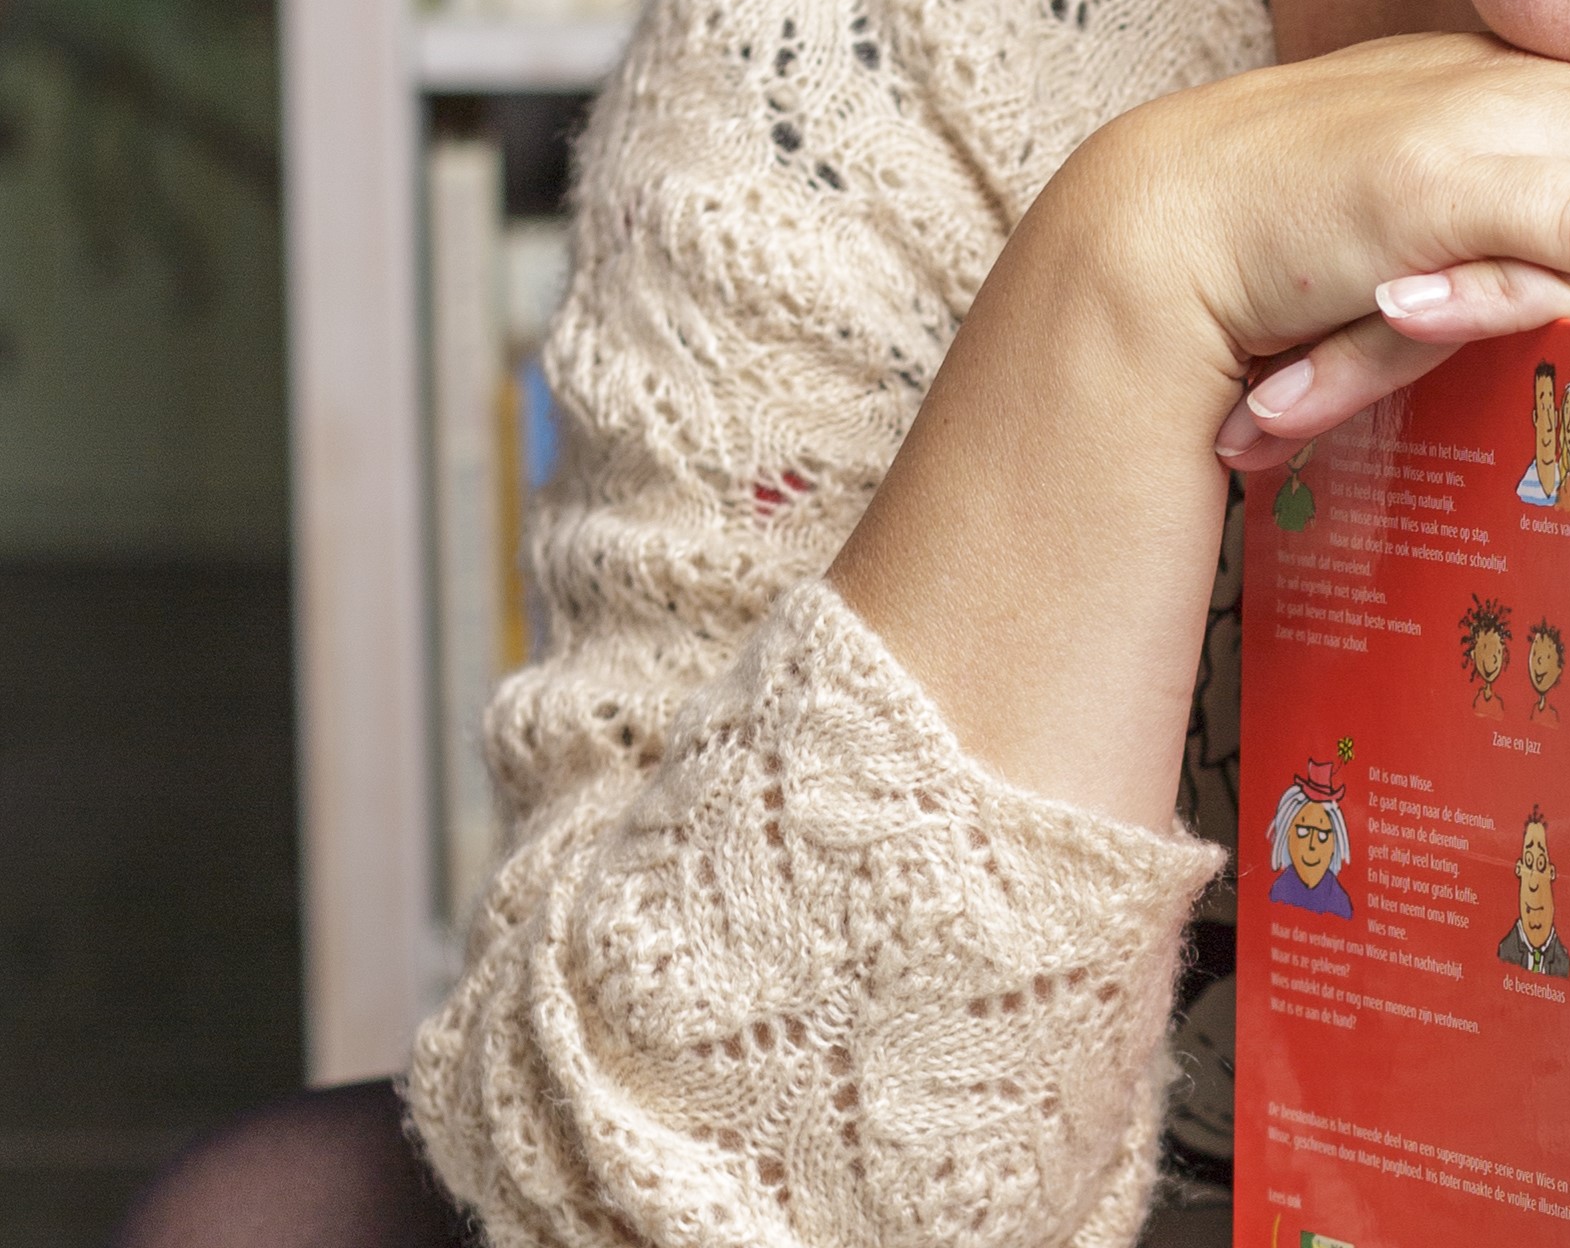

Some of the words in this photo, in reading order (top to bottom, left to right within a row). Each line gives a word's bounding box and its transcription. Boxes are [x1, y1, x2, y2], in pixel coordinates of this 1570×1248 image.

[1438, 442, 1450, 459] het
[1452, 444, 1495, 466] buitenland.
[1426, 470, 1443, 484] voor
[1445, 470, 1466, 487] Wies.
[1418, 494, 1456, 515] natuurlijk.
[1400, 516, 1419, 533] Wies
[1420, 519, 1439, 535] vaak
[1440, 524, 1458, 539] mee
[1459, 528, 1470, 543] op
[1471, 528, 1490, 547] stap.
[1520, 513, 1530, 530] de
[1531, 516, 1558, 535] ouders
[1395, 541, 1409, 556] ook
[1445, 549, 1468, 565] onder
[1469, 552, 1509, 574] schooltijd.
[1364, 611, 1386, 630] beste
[1387, 617, 1422, 636] vrienden
[1492, 731, 1512, 749] Zane
[1513, 738, 1524, 751] en
[1525, 737, 1541, 756] Jazz
[1369, 765, 1380, 782] Dit
[1382, 767, 1389, 784] is
[1390, 772, 1408, 788] oma
[1409, 774, 1435, 792] Wisse.
[1369, 791, 1379, 808] Ze
[1379, 797, 1398, 813] gaat
[1398, 800, 1421, 820] graag
[1422, 805, 1440, 819] naar
[1442, 805, 1452, 822] de
[1454, 807, 1497, 831] dierentuin.
[1368, 817, 1380, 834] De
[1380, 818, 1399, 837] baas
[1401, 826, 1416, 840] van
[1417, 825, 1428, 843] de
[1429, 828, 1470, 851] dierentuin
[1368, 844, 1389, 861] geeft
[1390, 846, 1410, 867] altijd
[1411, 852, 1429, 869] veel
[1430, 853, 1460, 879] korting.
[1368, 867, 1378, 884] En
[1379, 868, 1390, 889] hij
[1391, 874, 1411, 894] zorgt
[1412, 880, 1430, 895] voor
[1431, 883, 1453, 901] gratis
[1455, 884, 1480, 905] koffie.
[1368, 892, 1379, 909] Dit
[1380, 894, 1398, 913] keer
[1399, 902, 1426, 920] neemt
[1427, 908, 1446, 925] oma
[1446, 910, 1470, 930] Wisse
[1367, 917, 1386, 936] Wies
[1387, 925, 1409, 941] mee.
[1291, 953, 1300, 968] is
[1300, 955, 1310, 969] ze
[1311, 956, 1350, 979] gebleven?
[1346, 940, 1365, 957] oma
[1365, 943, 1389, 962] Wisse
[1389, 948, 1398, 964] in
[1398, 948, 1413, 968] het
[1413, 955, 1464, 983] nachtverblijf.
[1503, 973, 1514, 992] de
[1515, 975, 1566, 1004] beestenbaas
[1270, 995, 1286, 1013] Wat
[1287, 1001, 1294, 1016] is
[1295, 1004, 1304, 1018] er
[1304, 1006, 1320, 1022] aan
[1321, 1007, 1332, 1024] de
[1332, 1009, 1357, 1030] hand?
[1321, 982, 1335, 1001] dat
[1336, 988, 1345, 1002] er
[1346, 991, 1362, 1010] nog
[1362, 995, 1384, 1012] meer
[1385, 1000, 1418, 1020] mensen
[1418, 1006, 1433, 1026] zijn
[1433, 1012, 1480, 1034] verdwenen.
[1280, 1102, 1330, 1131] beestenbaas
[1330, 1115, 1337, 1132] is
[1337, 1117, 1351, 1135] het
[1352, 1123, 1383, 1145] tweede
[1384, 1130, 1402, 1150] deel
[1402, 1138, 1418, 1154] van
[1419, 1142, 1435, 1157] een
[1436, 1147, 1493, 1177] supergrappige
[1494, 1162, 1515, 1180] serie
[1515, 1168, 1534, 1185] over
[1535, 1171, 1556, 1190] Wies
[1557, 1179, 1569, 1194] en
[1293, 1135, 1338, 1157] geschreven
[1338, 1144, 1356, 1162] door
[1357, 1150, 1382, 1170] Marte
[1382, 1156, 1424, 1180] Jongbloed.
[1425, 1167, 1438, 1184] Iris
[1439, 1170, 1461, 1191] Boter
[1462, 1179, 1493, 1200] maakte
[1494, 1185, 1505, 1203] de
[1506, 1192, 1537, 1213] vrolijke
